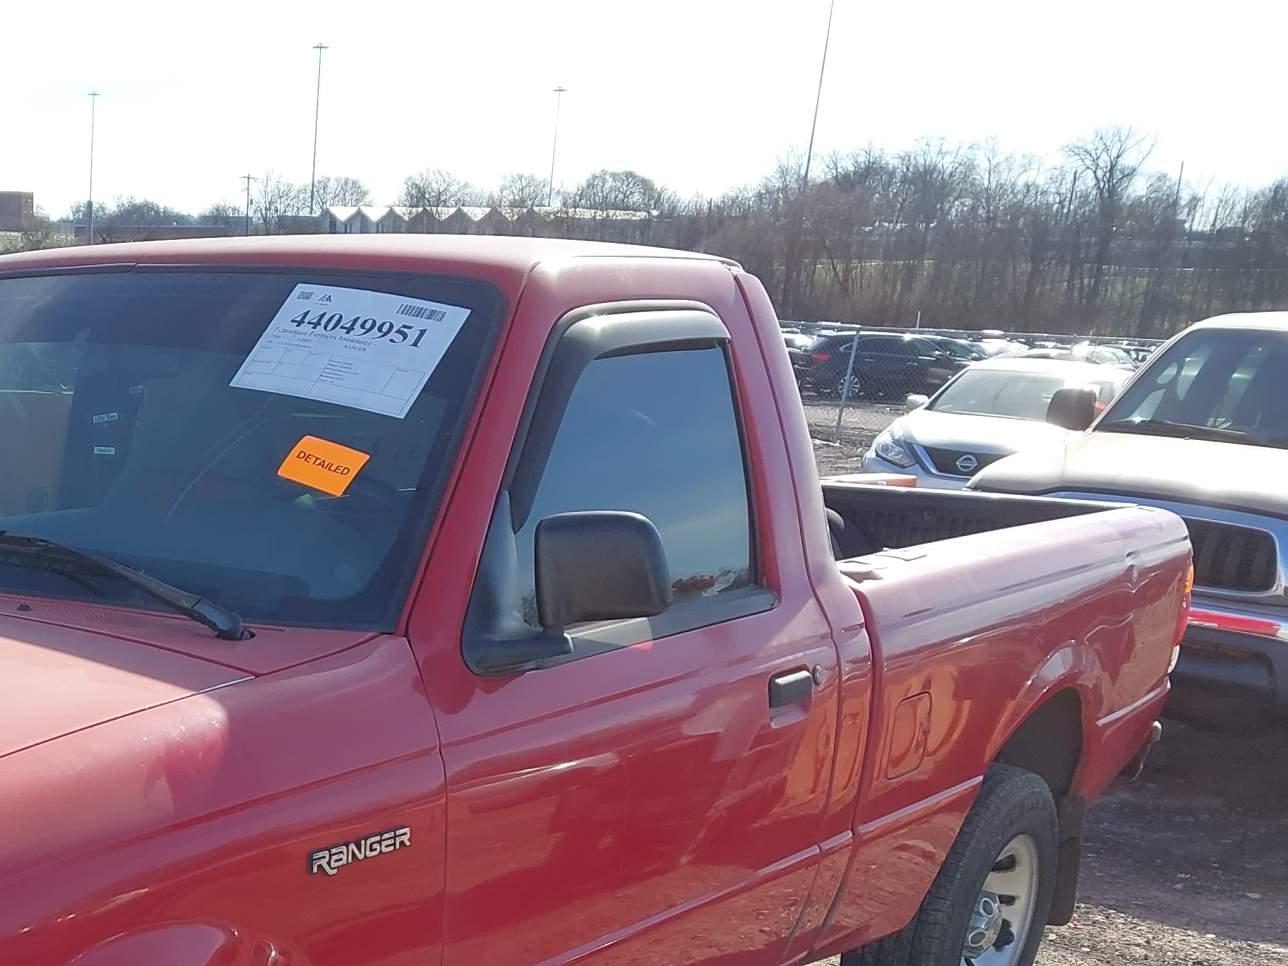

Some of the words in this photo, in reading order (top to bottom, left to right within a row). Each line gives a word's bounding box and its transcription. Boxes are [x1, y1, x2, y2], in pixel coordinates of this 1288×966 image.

[291, 309, 428, 348] 44049951
[296, 450, 350, 475] DETAILED
[312, 827, 411, 875] RANGER
